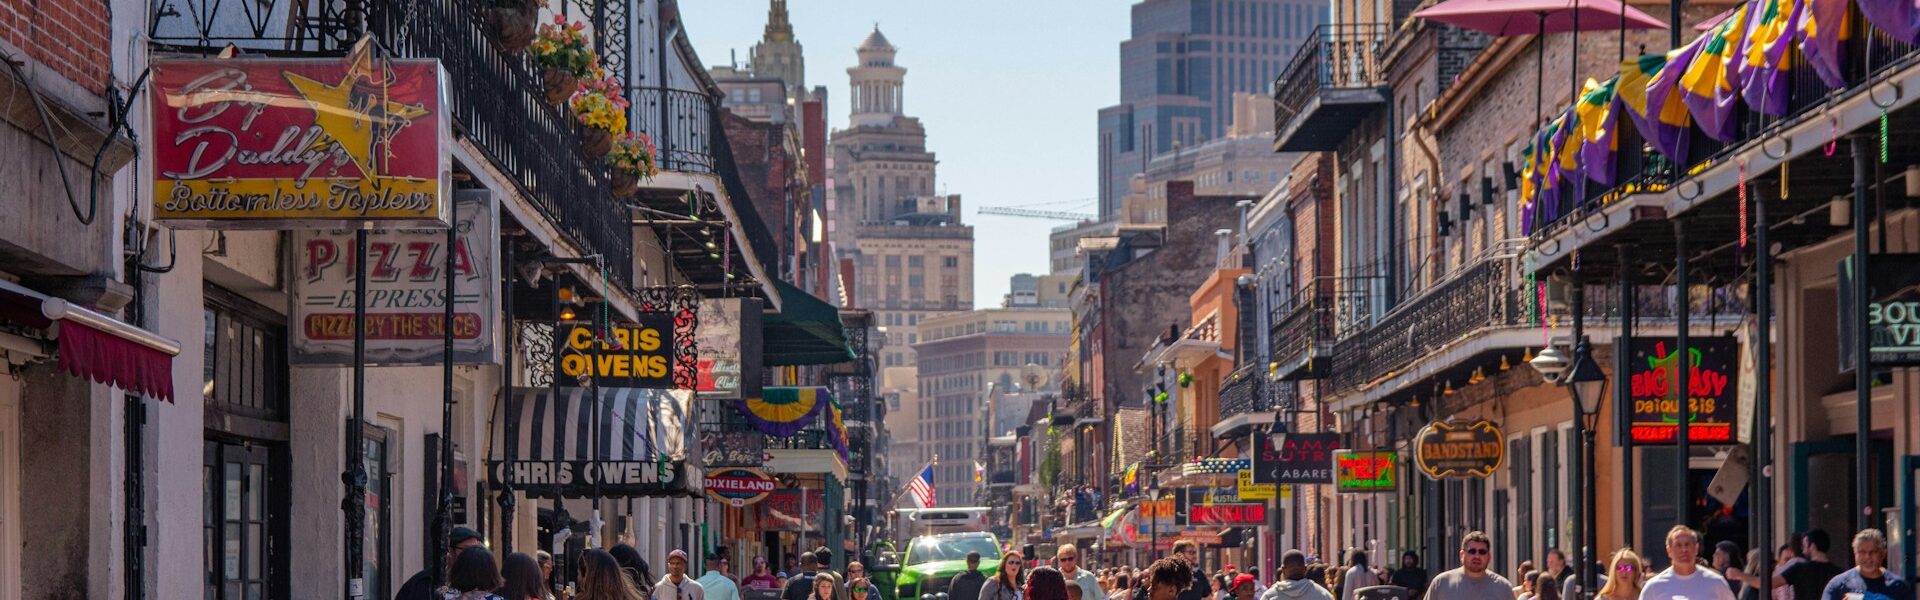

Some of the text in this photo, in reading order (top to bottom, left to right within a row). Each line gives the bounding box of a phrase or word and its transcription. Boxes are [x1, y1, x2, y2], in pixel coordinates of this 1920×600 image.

[177, 68, 272, 131] Big
[163, 125, 350, 189] Daddy's
[164, 181, 433, 216] Bottomless Topless
[306, 236, 480, 284] PIZZA
[311, 315, 356, 336] PIZZA
[391, 316, 422, 336] THE
[428, 316, 474, 337] SLCE
[570, 327, 661, 352] CRIS
[561, 354, 668, 378] OWENS
[1632, 365, 1727, 397] BIG ASY
[1264, 450, 1333, 462] SUTR
[1424, 441, 1500, 459] BANDSTAND
[496, 462, 573, 485] CHRIS
[583, 461, 675, 484] OWENS
[704, 478, 775, 491] DIXIELAND
[1246, 505, 1264, 522] CLUB
